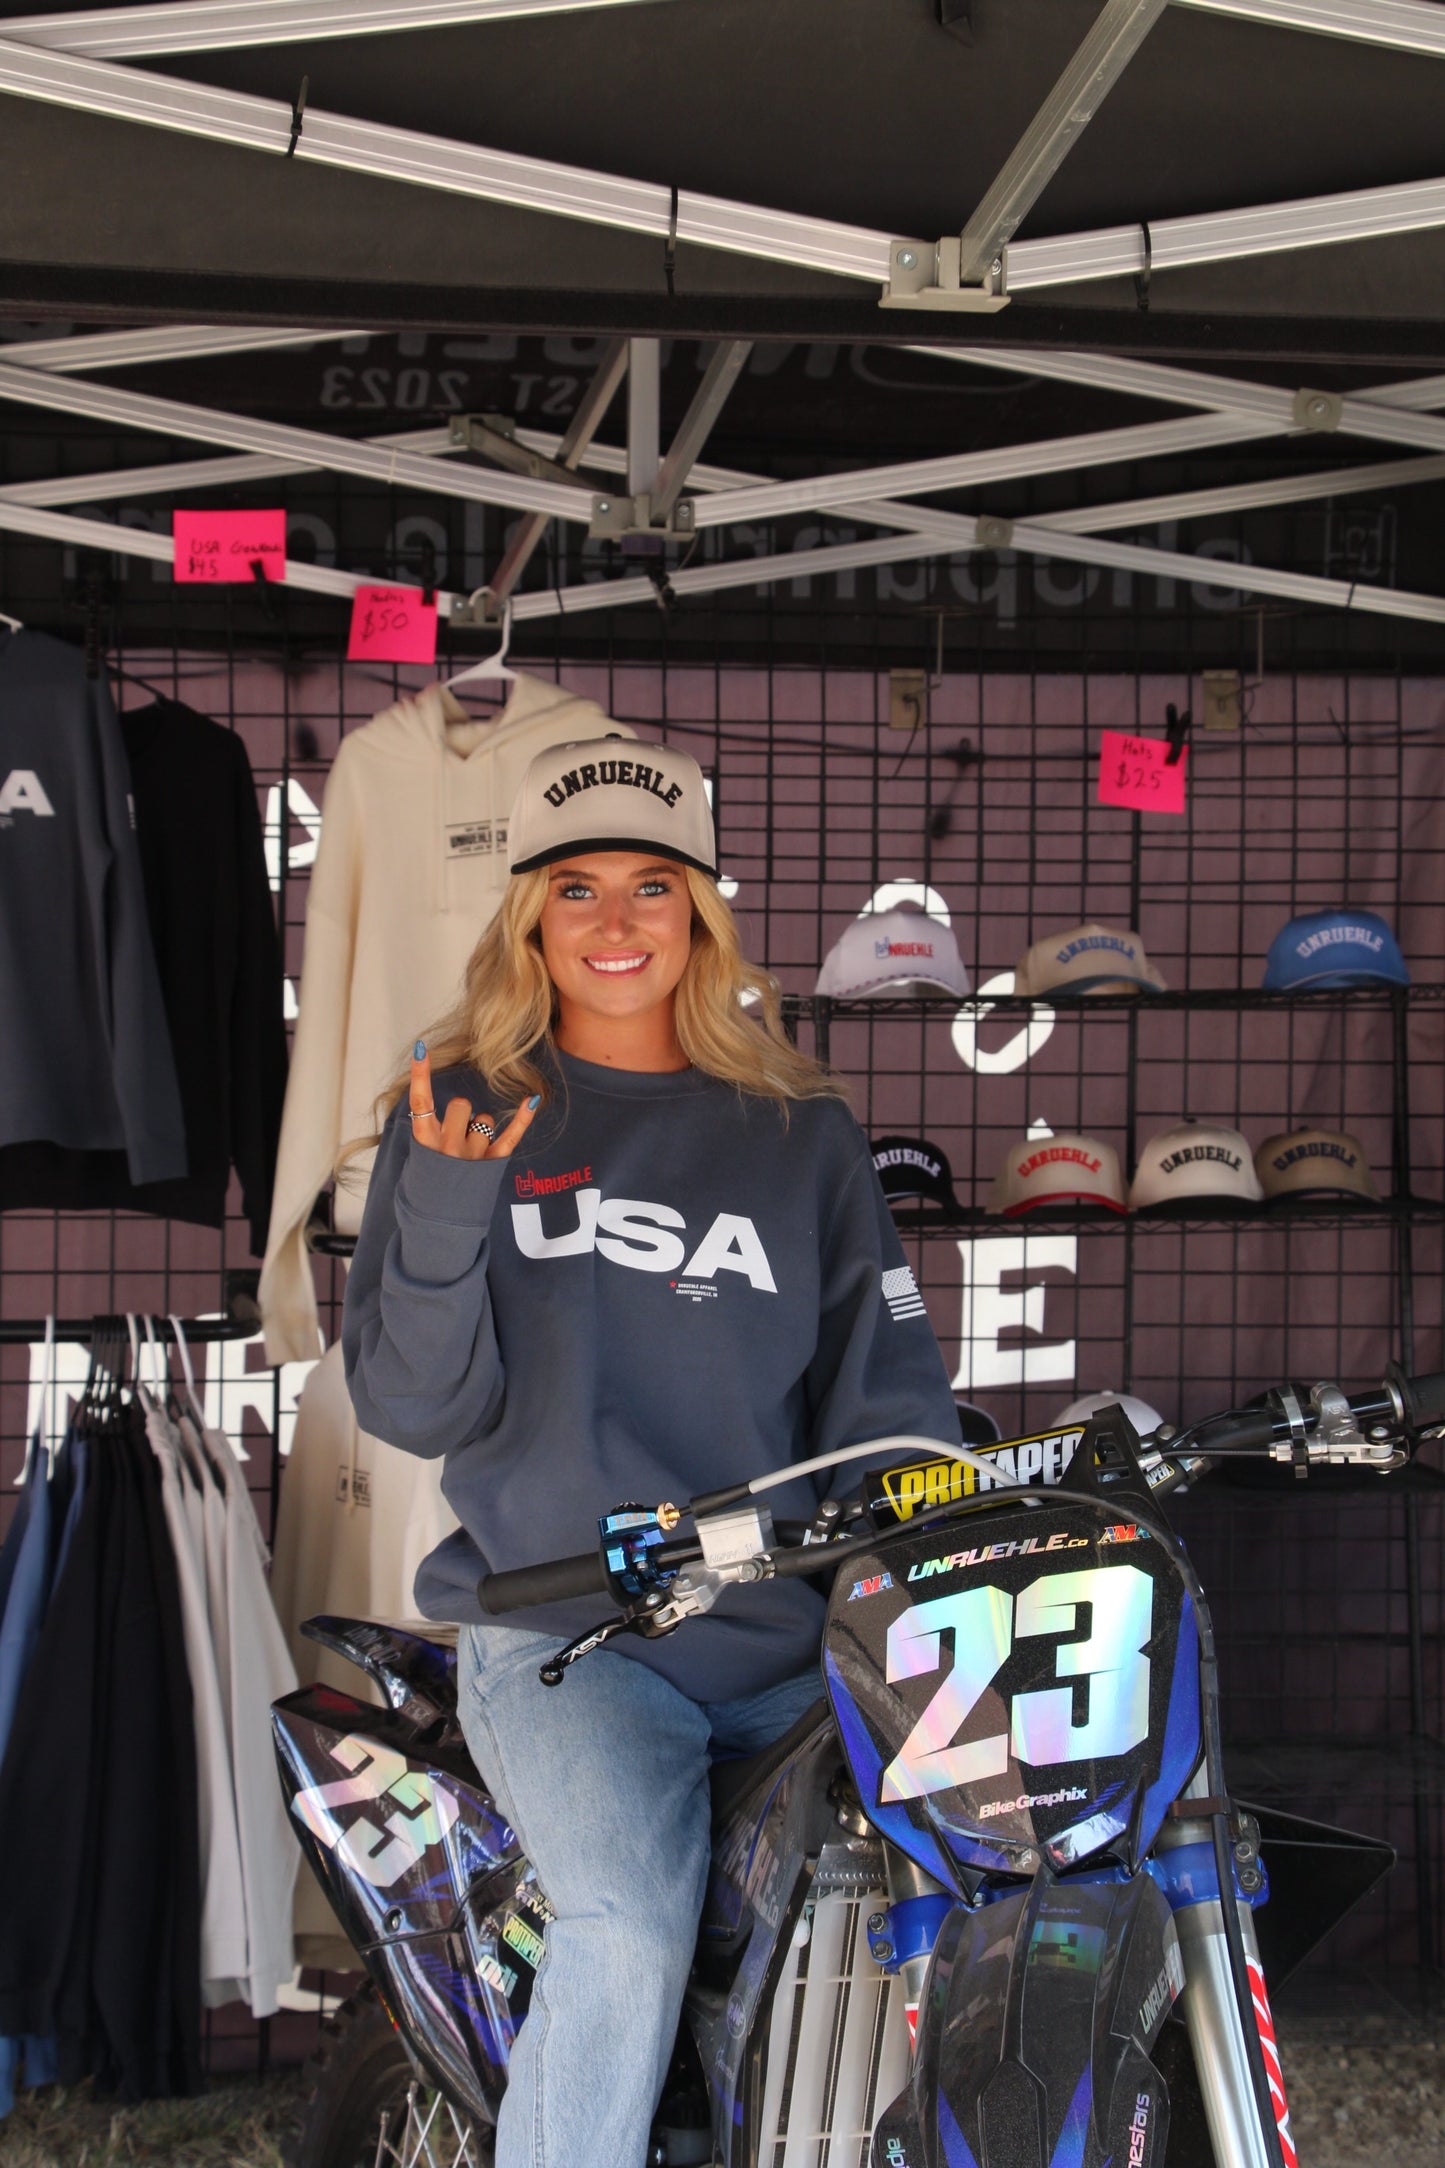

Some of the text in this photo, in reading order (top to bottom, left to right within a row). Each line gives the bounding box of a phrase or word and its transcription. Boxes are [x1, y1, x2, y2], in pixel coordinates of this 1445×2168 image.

[190, 538, 220, 555] USA
[189, 556, 218, 577] $45
[361, 609, 409, 642] $50
[1122, 738, 1152, 760] Hats
[543, 760, 683, 808] UNRUEHLE
[1116, 761, 1164, 789] $25
[1056, 935, 1135, 965] UNRUEHLE
[1296, 926, 1384, 959] UNRUEHLE
[1018, 1147, 1103, 1178] UNRUEHLE
[1160, 1145, 1243, 1174] UNRUEHLE
[1272, 1142, 1358, 1171] UNRUEHLE
[510, 1188, 778, 1294] USA
[847, 1572, 894, 1601] AMA
[562, 1629, 608, 1663] ASV
[880, 1564, 1154, 1803] 23
[291, 1734, 460, 1888] 23
[979, 1786, 1088, 1820] BikeGraphix
